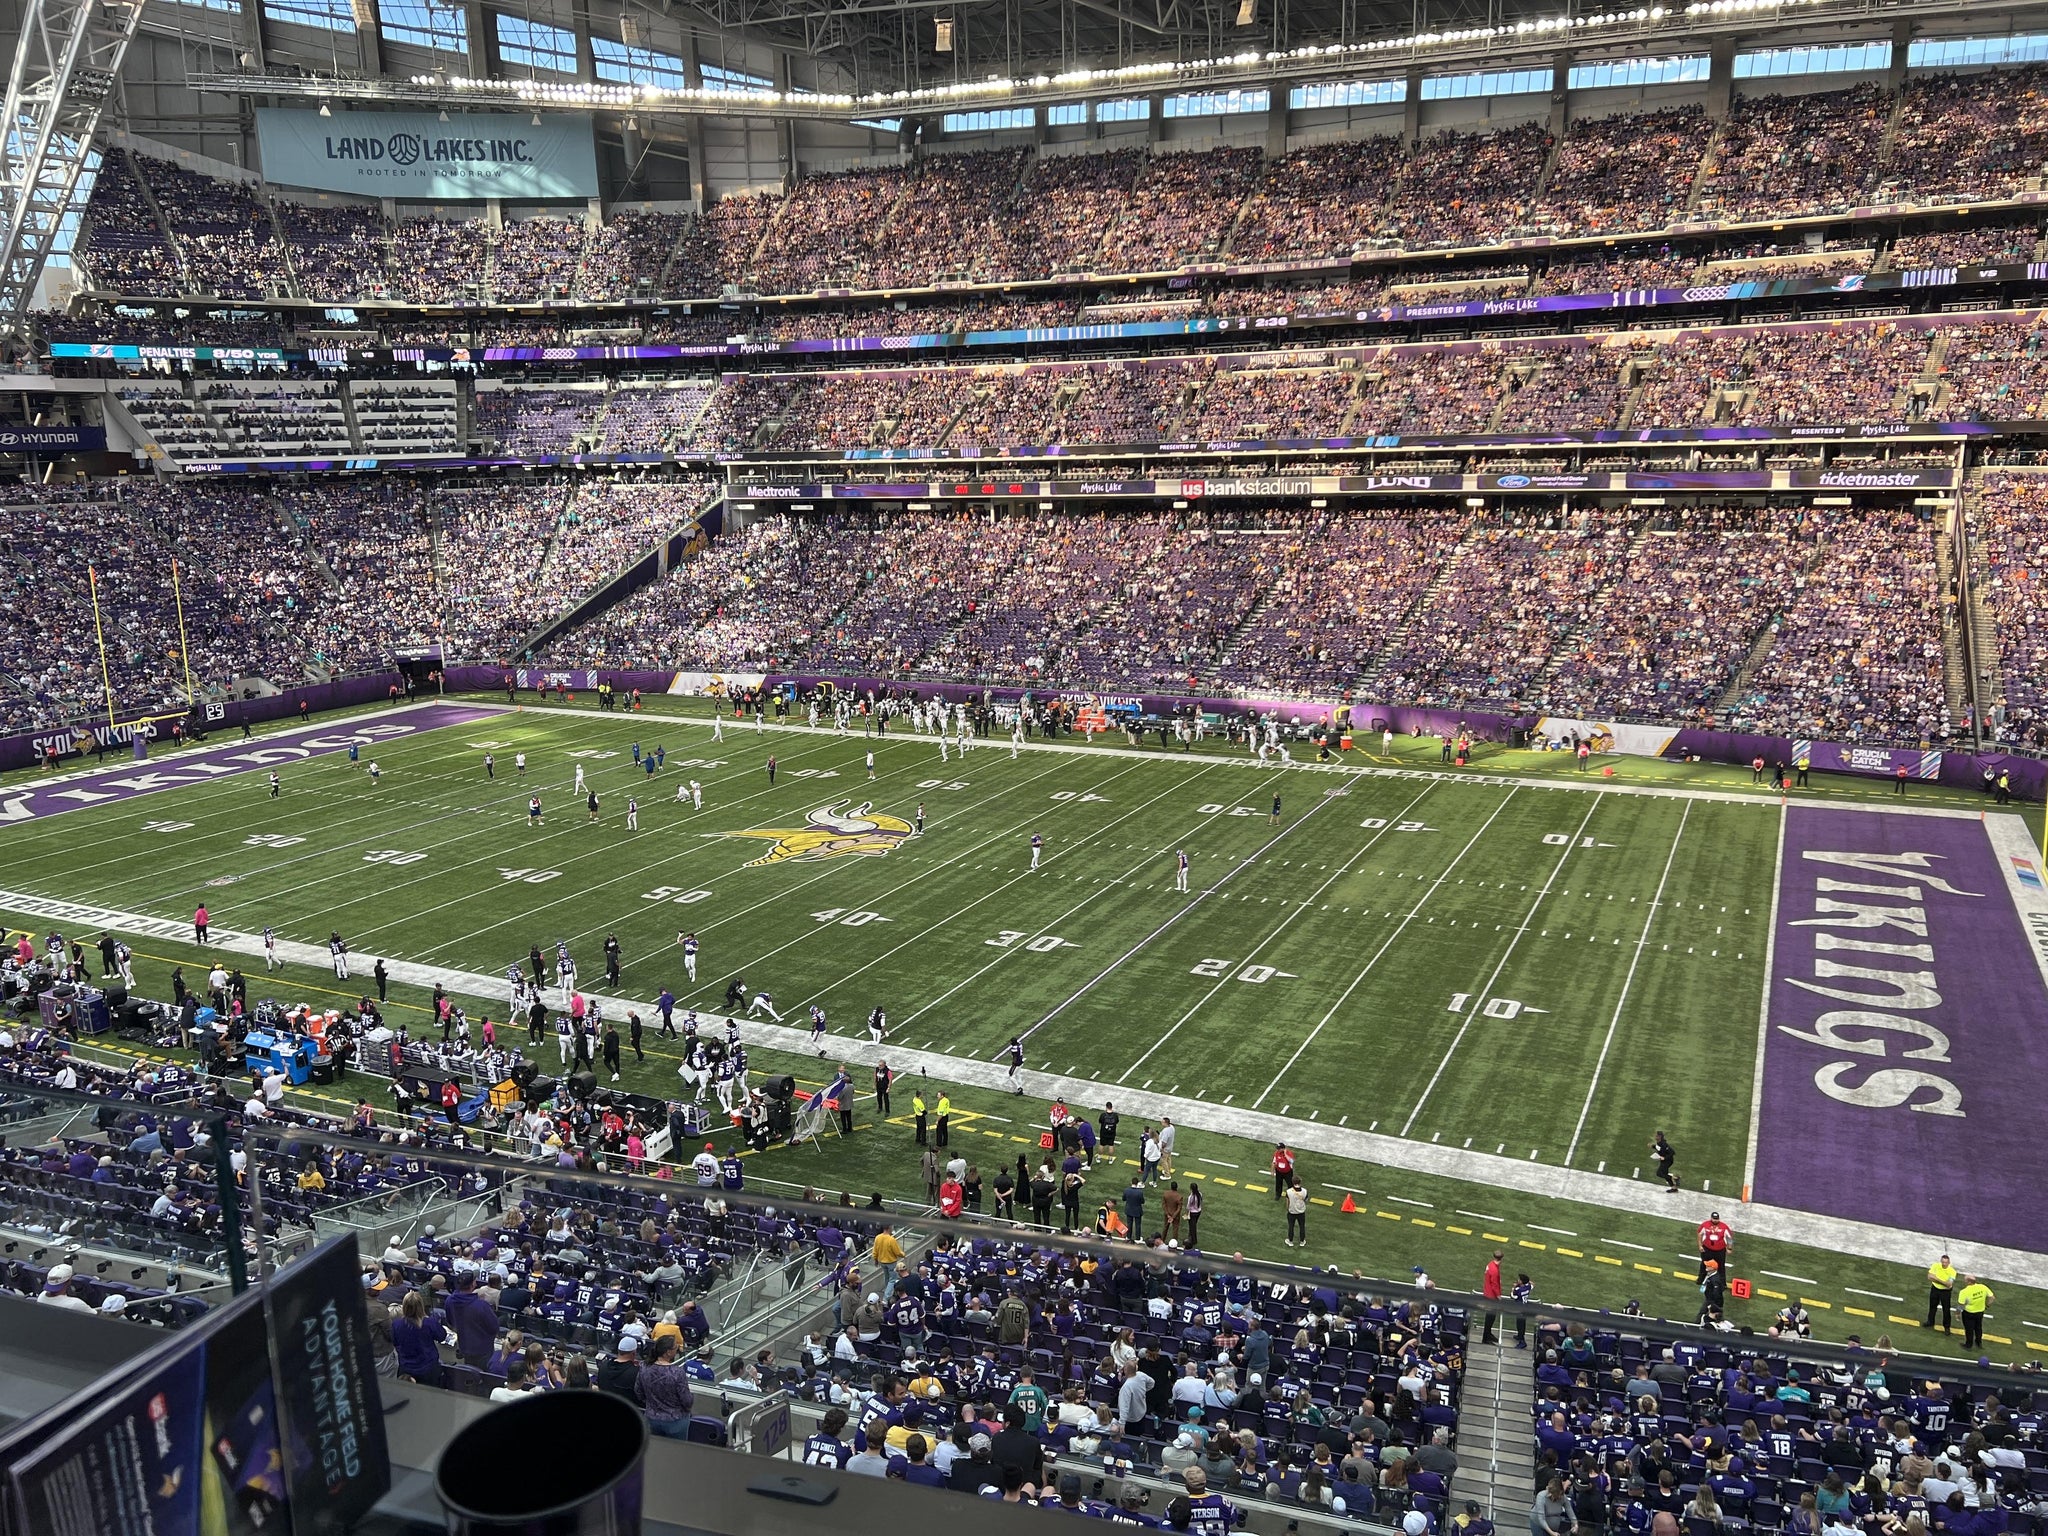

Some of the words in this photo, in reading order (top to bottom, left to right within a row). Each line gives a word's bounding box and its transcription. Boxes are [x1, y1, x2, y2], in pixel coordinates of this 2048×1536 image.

[325, 136, 384, 159] LAND
[491, 139, 533, 161] INC.
[358, 168, 407, 177] ROOTED
[413, 169, 426, 177] IN
[433, 170, 502, 178] TOMORROW
[1406, 307, 1449, 318] PRESENTED
[1452, 305, 1468, 314] BY
[1255, 317, 1288, 328] 2:36
[139, 347, 196, 358] PENALTIES
[212, 349, 254, 359] 8/50
[681, 346, 717, 355] PRESENTED
[718, 346, 728, 354] BY
[1250, 354, 1289, 366] MINNESOTA
[1297, 352, 1327, 363] VIKINGS
[22, 433, 79, 443] HYUNDAI
[1791, 428, 1834, 436] PRESENTED
[1366, 477, 1431, 489] LUND
[1819, 472, 1919, 487] ticketmaster
[747, 485, 801, 497] Medtronic
[954, 484, 969, 494] 3M
[981, 484, 995, 494] 3M
[1008, 484, 1023, 494] 3M
[207, 704, 223, 719] 25
[32, 731, 76, 760] SKOL
[1851, 756, 1882, 766] CATCH
[1852, 748, 1892, 760] CRUCIAL
[1399, 771, 1522, 784] CANCER
[915, 779, 970, 791] 50
[1195, 803, 1257, 817] 30
[150, 820, 196, 833] 10
[1359, 817, 1425, 833] 20
[247, 833, 307, 849] 20
[1541, 833, 1595, 849] 10
[366, 848, 430, 866] 30
[501, 867, 564, 884] 40
[641, 885, 714, 904] 50
[810, 907, 882, 927] 40
[985, 930, 1066, 953] 30
[1190, 957, 1279, 985] 20
[1777, 850, 1986, 1118] VIKINGS
[1448, 991, 1523, 1020] 10
[163, 1070, 179, 1081] 22
[1042, 1135, 1053, 1146] 20
[268, 1172, 281, 1182] 43
[725, 1169, 738, 1179] 43
[1237, 1279, 1250, 1292] 43
[1271, 1284, 1289, 1300] 87
[1735, 1281, 1746, 1296] G
[578, 1290, 590, 1304] 19
[897, 1307, 919, 1326] 84
[1010, 1310, 1021, 1324] 18
[1183, 1309, 1193, 1323] 9
[1203, 1312, 1221, 1325] 82
[321, 1298, 343, 1358] YOUR
[1681, 1346, 1698, 1354] MURRAY
[1687, 1356, 1693, 1366] 1
[330, 1358, 353, 1424] HOME
[1282, 1382, 1299, 1391] JEFFERSON
[302, 1317, 342, 1486] ADVANTAGE
[1440, 1391, 1450, 1405] 5
[859, 1409, 878, 1432] 5
[1925, 1414, 1947, 1431] 10
[763, 1411, 788, 1450] 128
[339, 1421, 361, 1478] FIELD
[811, 1440, 820, 1449] VAN
[1774, 1440, 1791, 1456] 18
